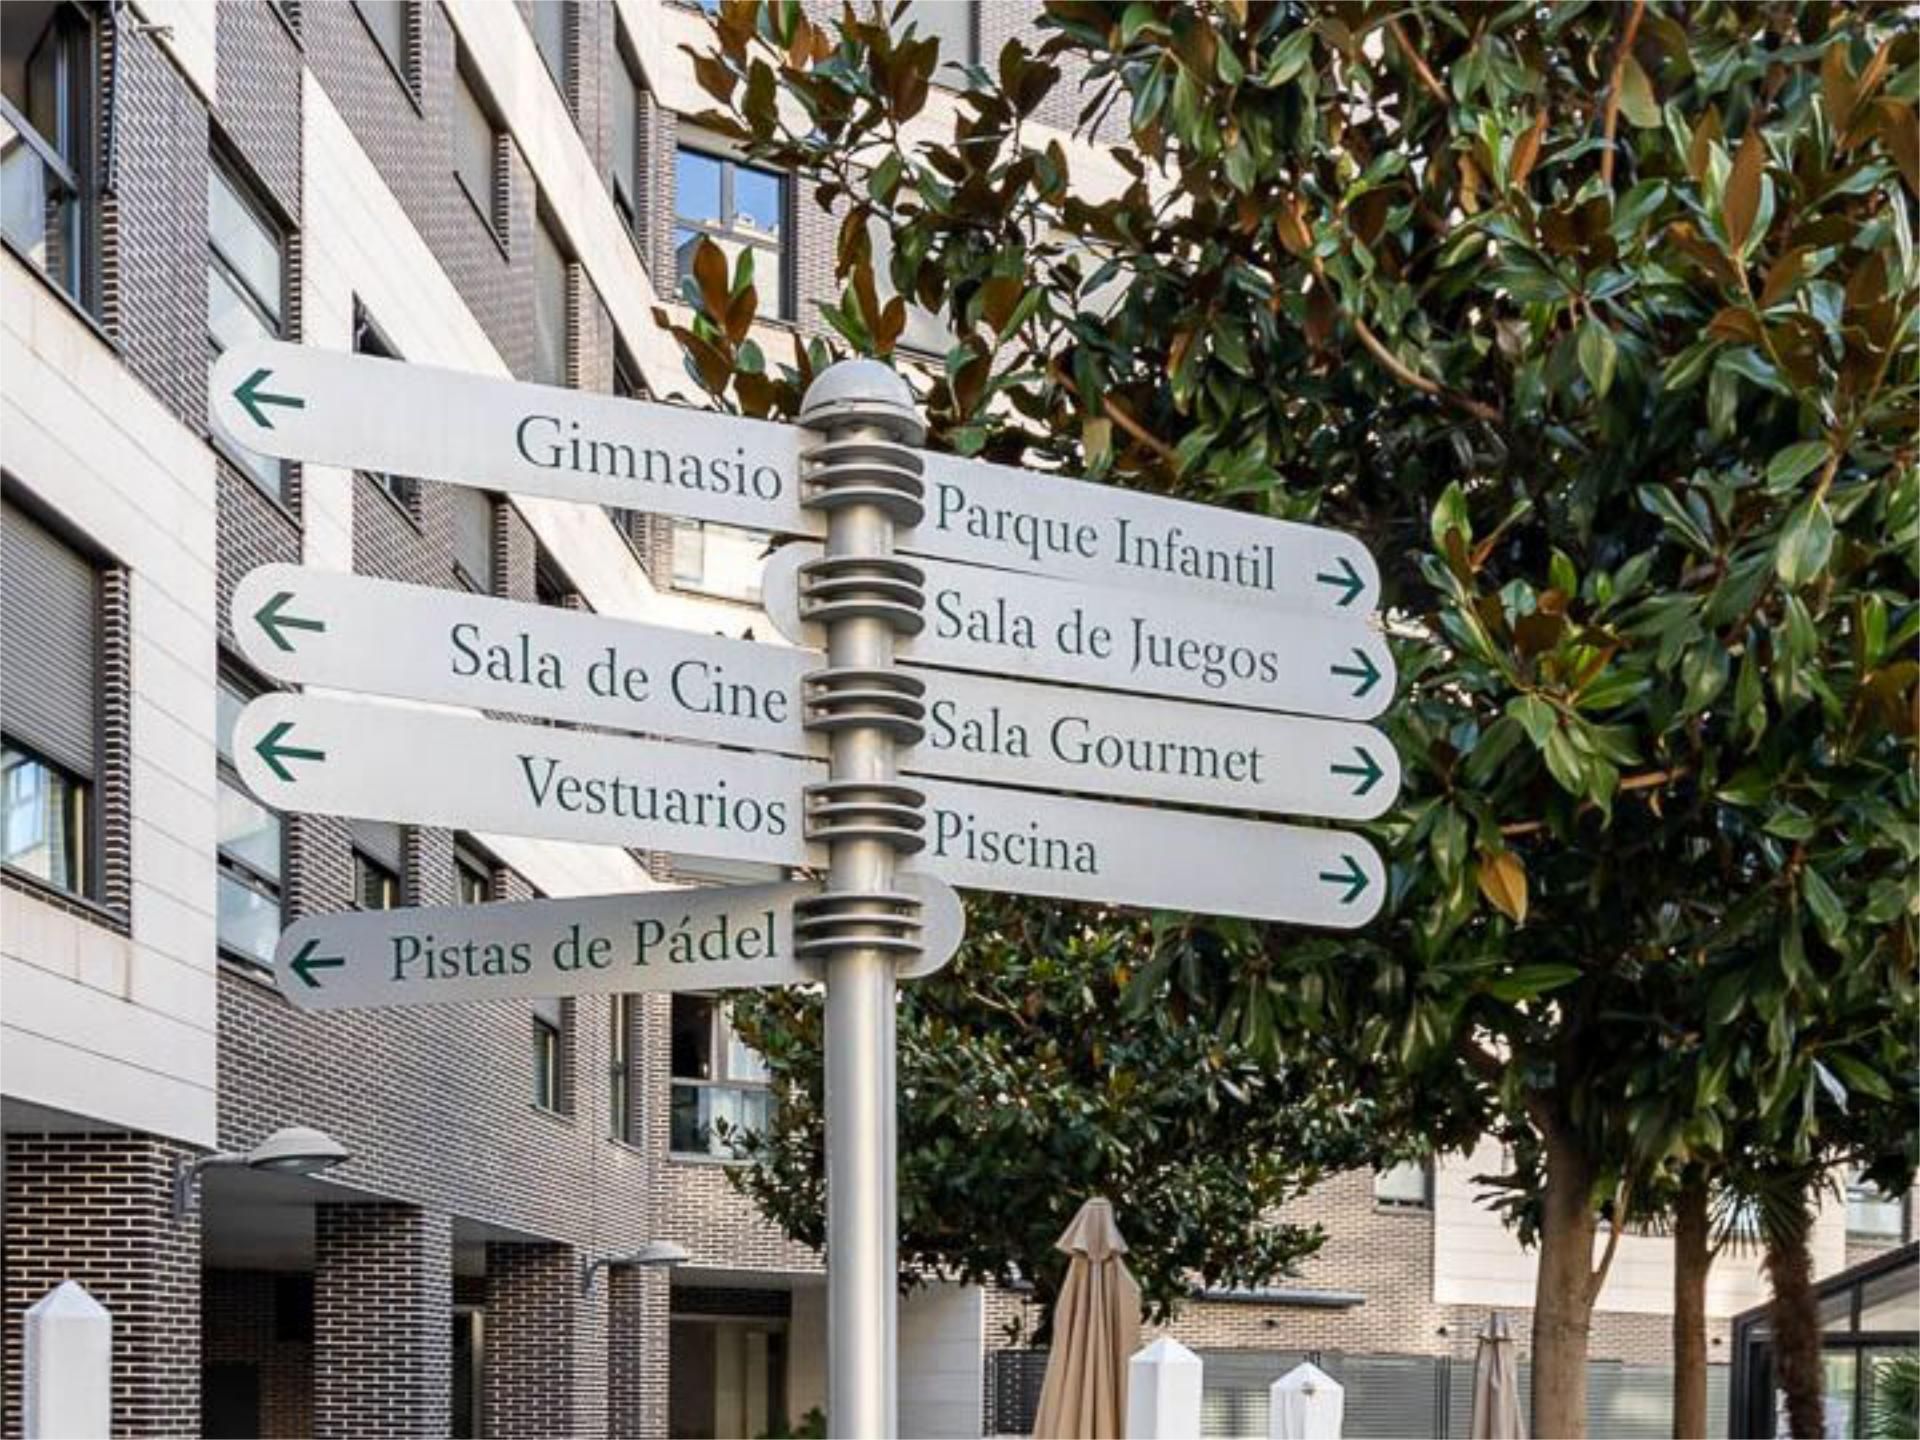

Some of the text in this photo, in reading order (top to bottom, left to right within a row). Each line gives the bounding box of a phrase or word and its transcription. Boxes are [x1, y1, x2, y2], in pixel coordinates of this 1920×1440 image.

[516, 414, 783, 500] Gimnasio
[936, 482, 1274, 591] Parque Infantil
[450, 623, 788, 724] Sala de Cine
[935, 589, 1278, 687] Sala de Juegos
[931, 700, 1263, 785] Sala Gourmet
[516, 753, 786, 836] Vestuarios
[933, 809, 1098, 875] Piscina
[391, 911, 776, 981] Pistas de Pádel
